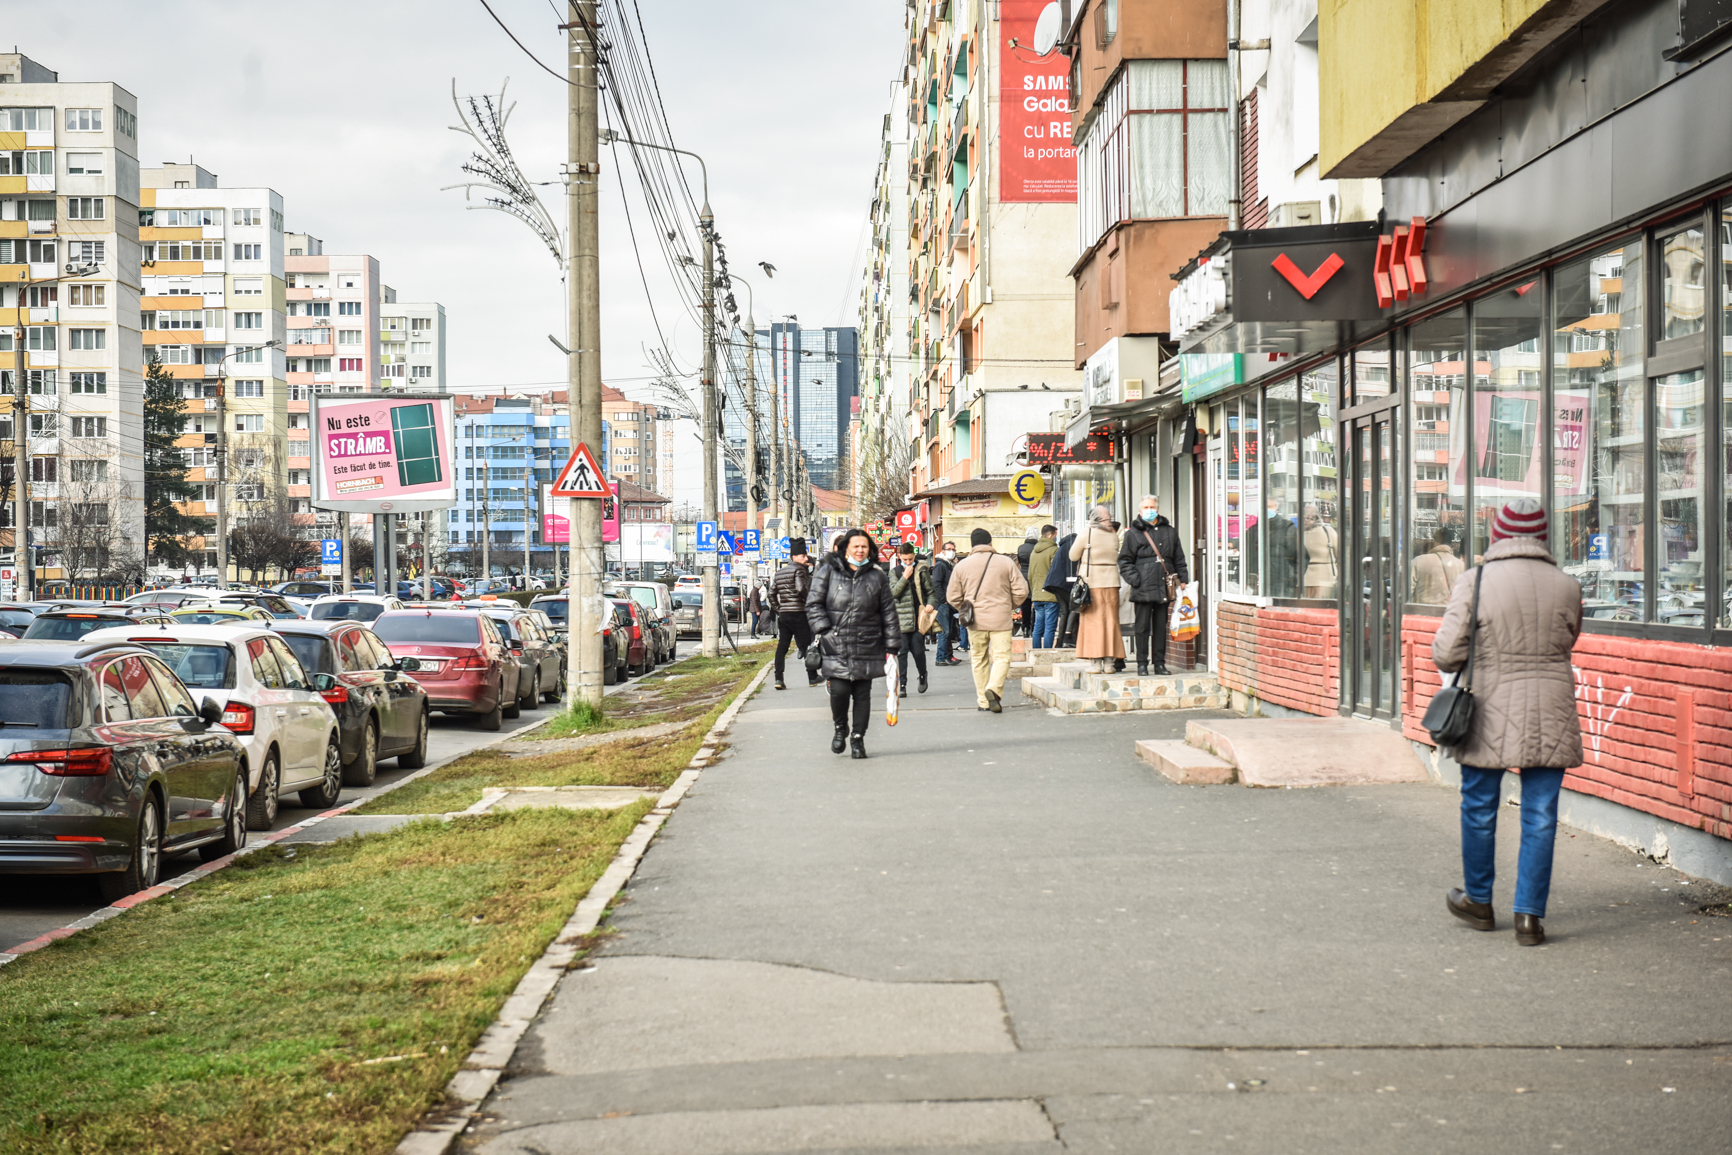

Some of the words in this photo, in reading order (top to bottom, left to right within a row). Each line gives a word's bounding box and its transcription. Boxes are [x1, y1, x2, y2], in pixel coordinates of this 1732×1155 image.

[1023, 96, 1071, 112] Gala
[1024, 125, 1044, 138] cu
[1049, 121, 1071, 138] RE
[1024, 145, 1034, 158] la
[327, 417, 342, 431] Nu
[346, 414, 371, 428] este
[330, 432, 390, 456] STRÂMB.
[334, 465, 348, 474] Este
[350, 462, 366, 473] făcut
[368, 462, 376, 470] de
[702, 524, 712, 542] P
[746, 531, 756, 544] P
[326, 541, 337, 556] P
